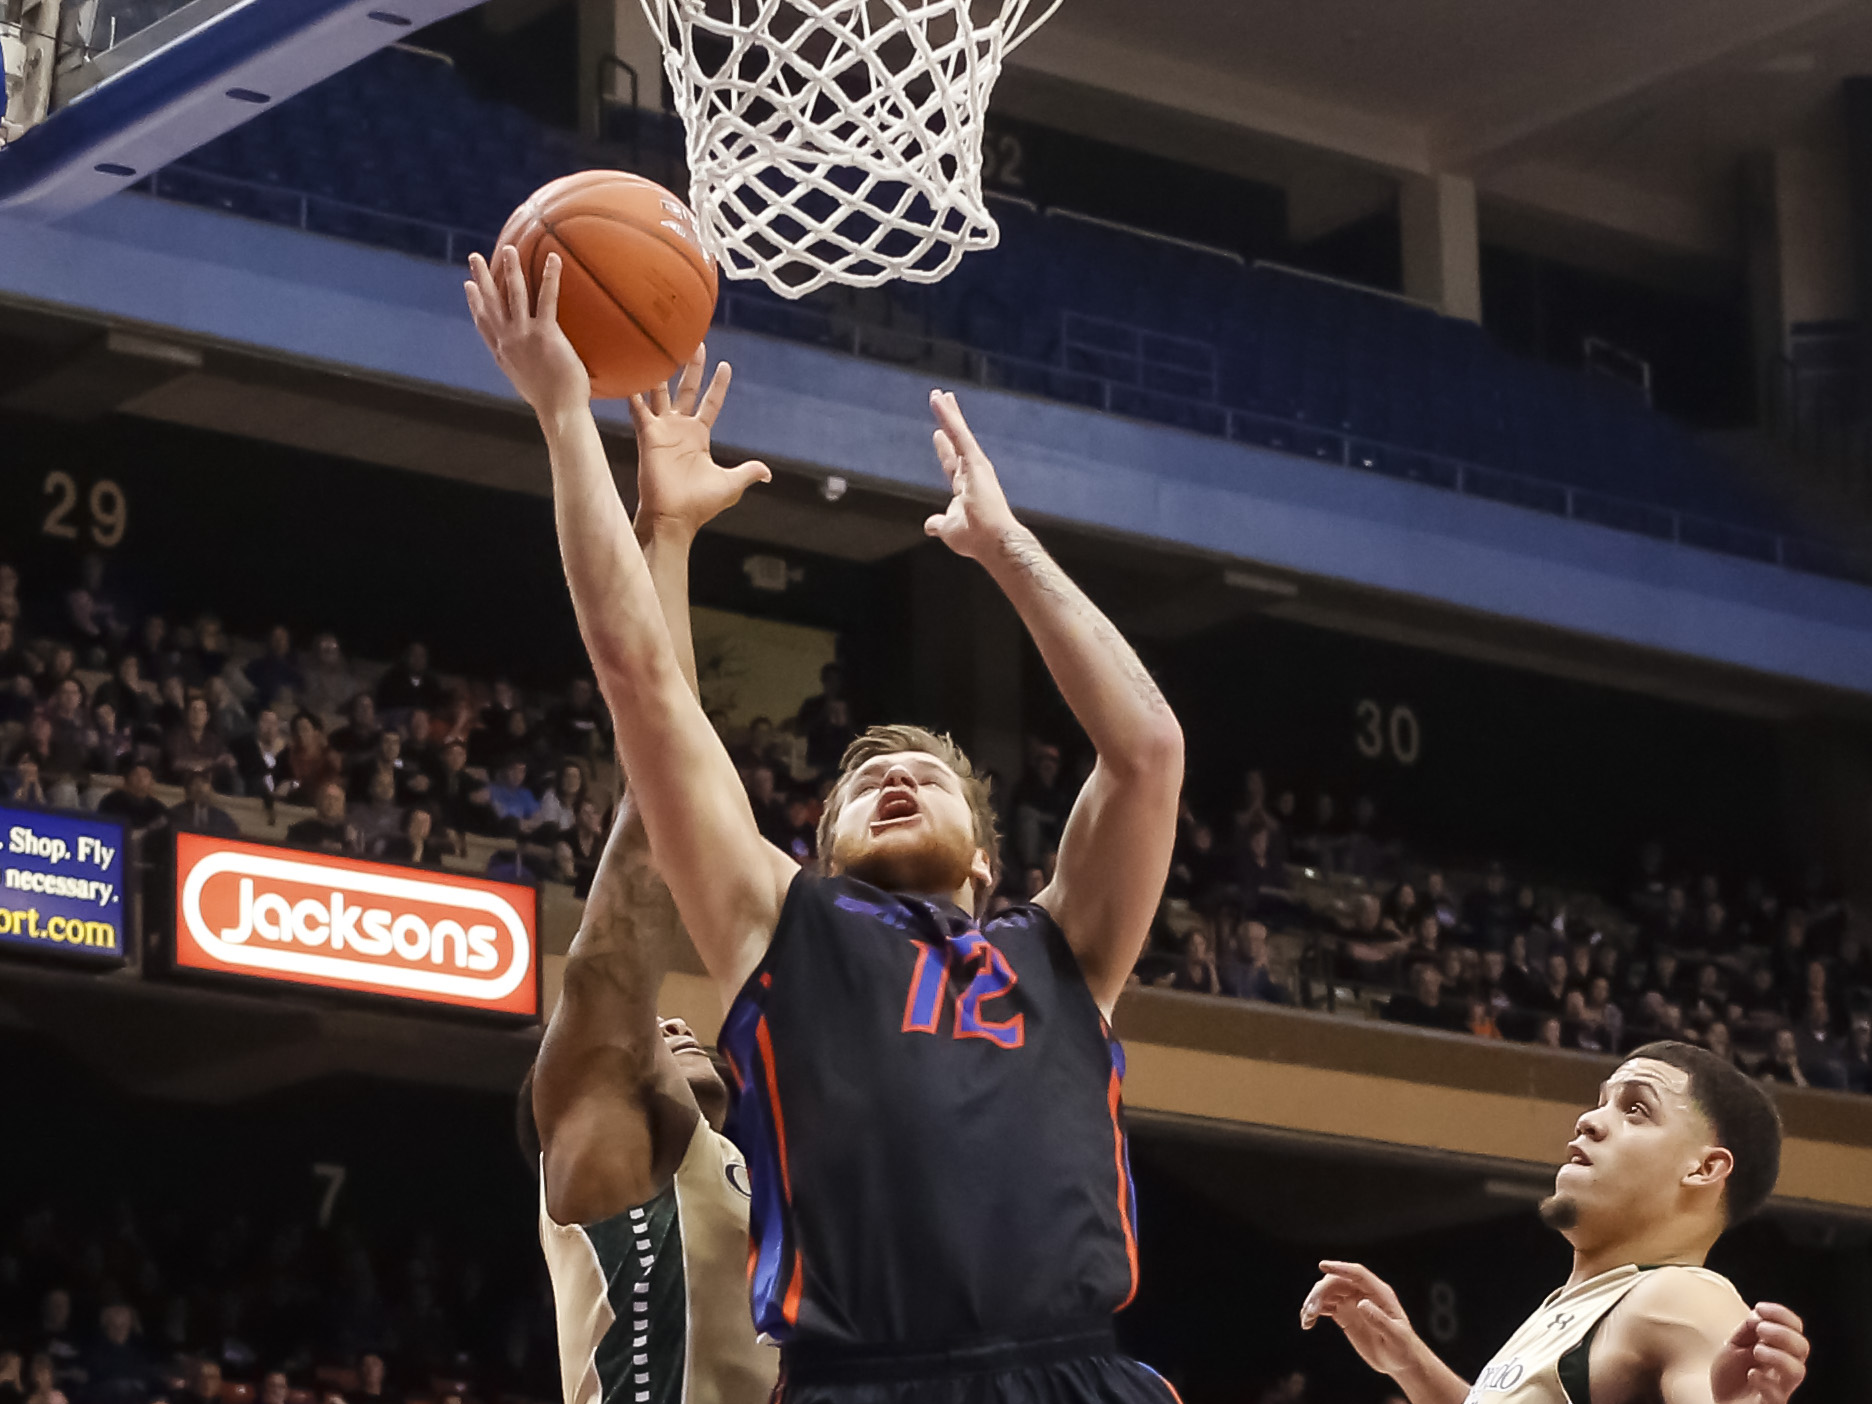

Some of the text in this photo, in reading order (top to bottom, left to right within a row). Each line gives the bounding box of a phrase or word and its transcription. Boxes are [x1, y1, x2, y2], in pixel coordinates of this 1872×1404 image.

[43, 471, 127, 546] 29
[1357, 699, 1419, 763] 30
[9, 826, 115, 871] Shop. Fly
[5, 868, 119, 907] necessary.
[221, 878, 499, 971] Jacksons
[901, 929, 1024, 1049] 12
[313, 1163, 345, 1229] 7
[1430, 1282, 1457, 1341] 8
